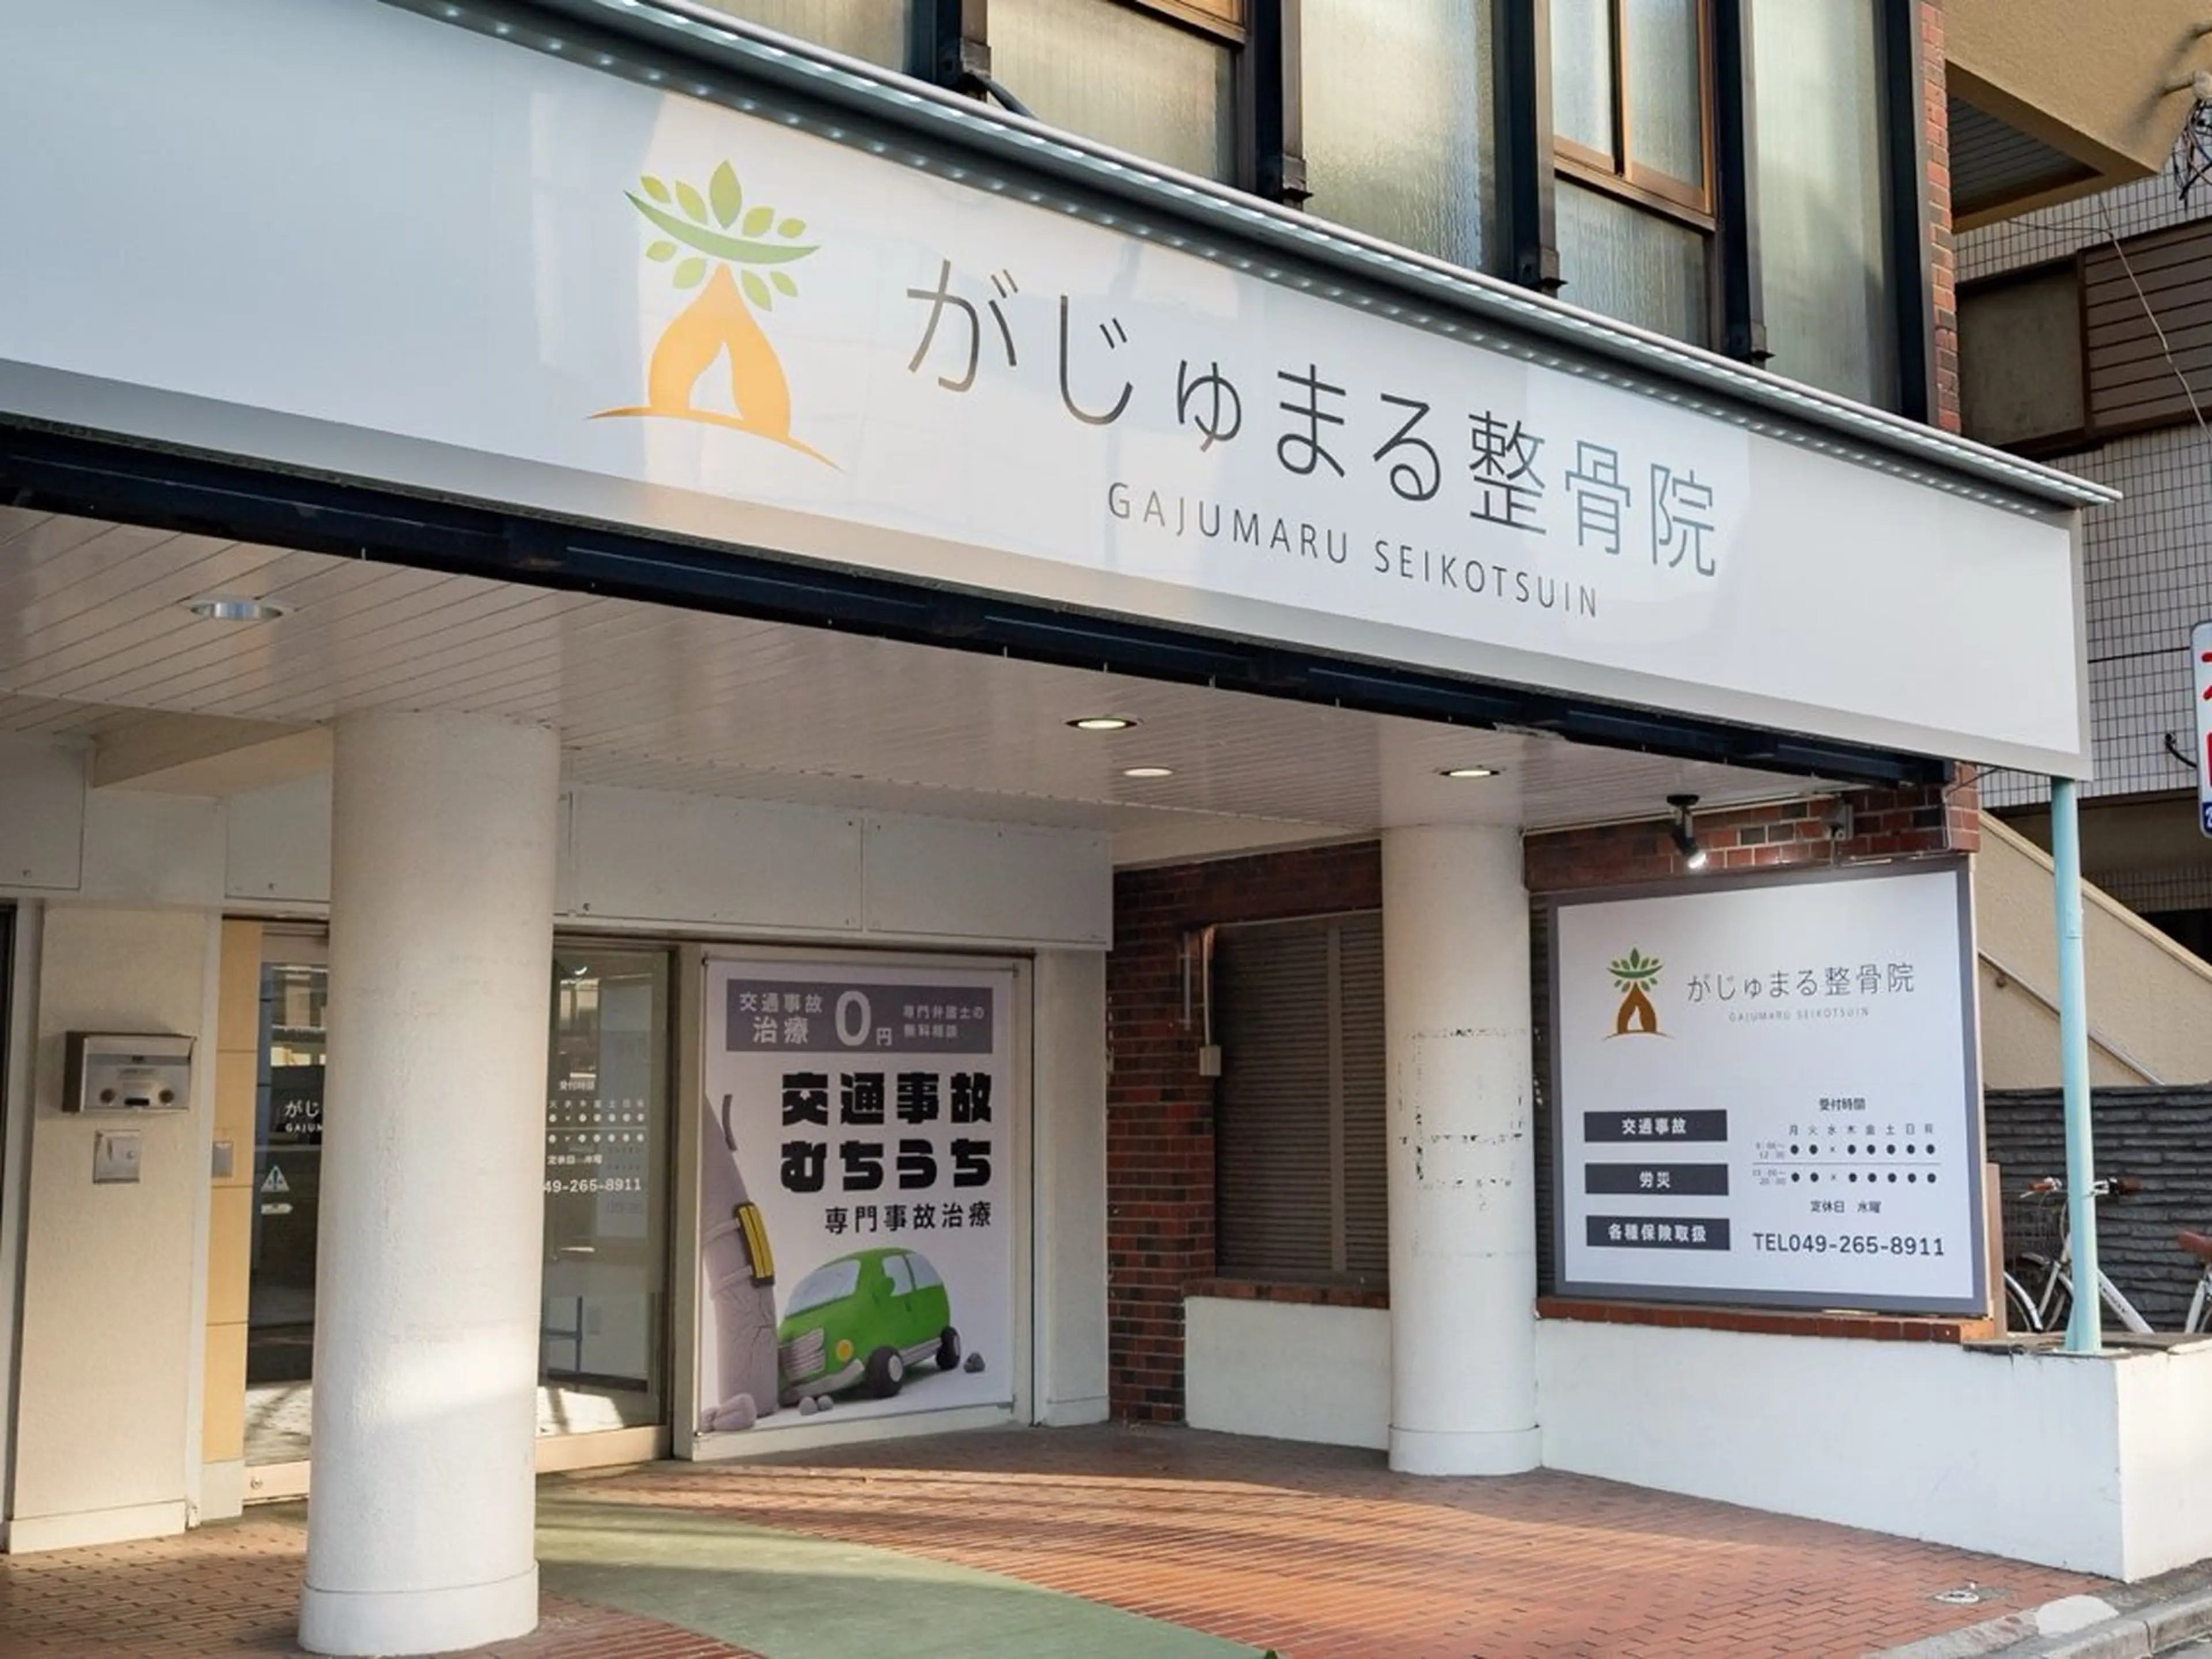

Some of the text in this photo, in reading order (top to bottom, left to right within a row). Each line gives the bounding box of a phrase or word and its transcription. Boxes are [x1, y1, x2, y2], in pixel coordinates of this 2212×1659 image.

[907, 258, 1715, 576] がじゅまる整骨院
[1108, 482, 1596, 617] GAJUMARU SEIKOTSUIN
[1687, 962, 1914, 1003] がじゅまる整骨院
[740, 991, 823, 1013] 交通事故
[752, 1016, 808, 1044] 治療
[782, 1072, 992, 1126] 交通事故
[1622, 1117, 1687, 1135] 交通事故
[781, 1138, 991, 1193] むちうち
[1639, 1171, 1671, 1188] 労災
[825, 1202, 992, 1235] 専門事故治療
[1752, 1232, 1945, 1256] TEL049-265-8911
